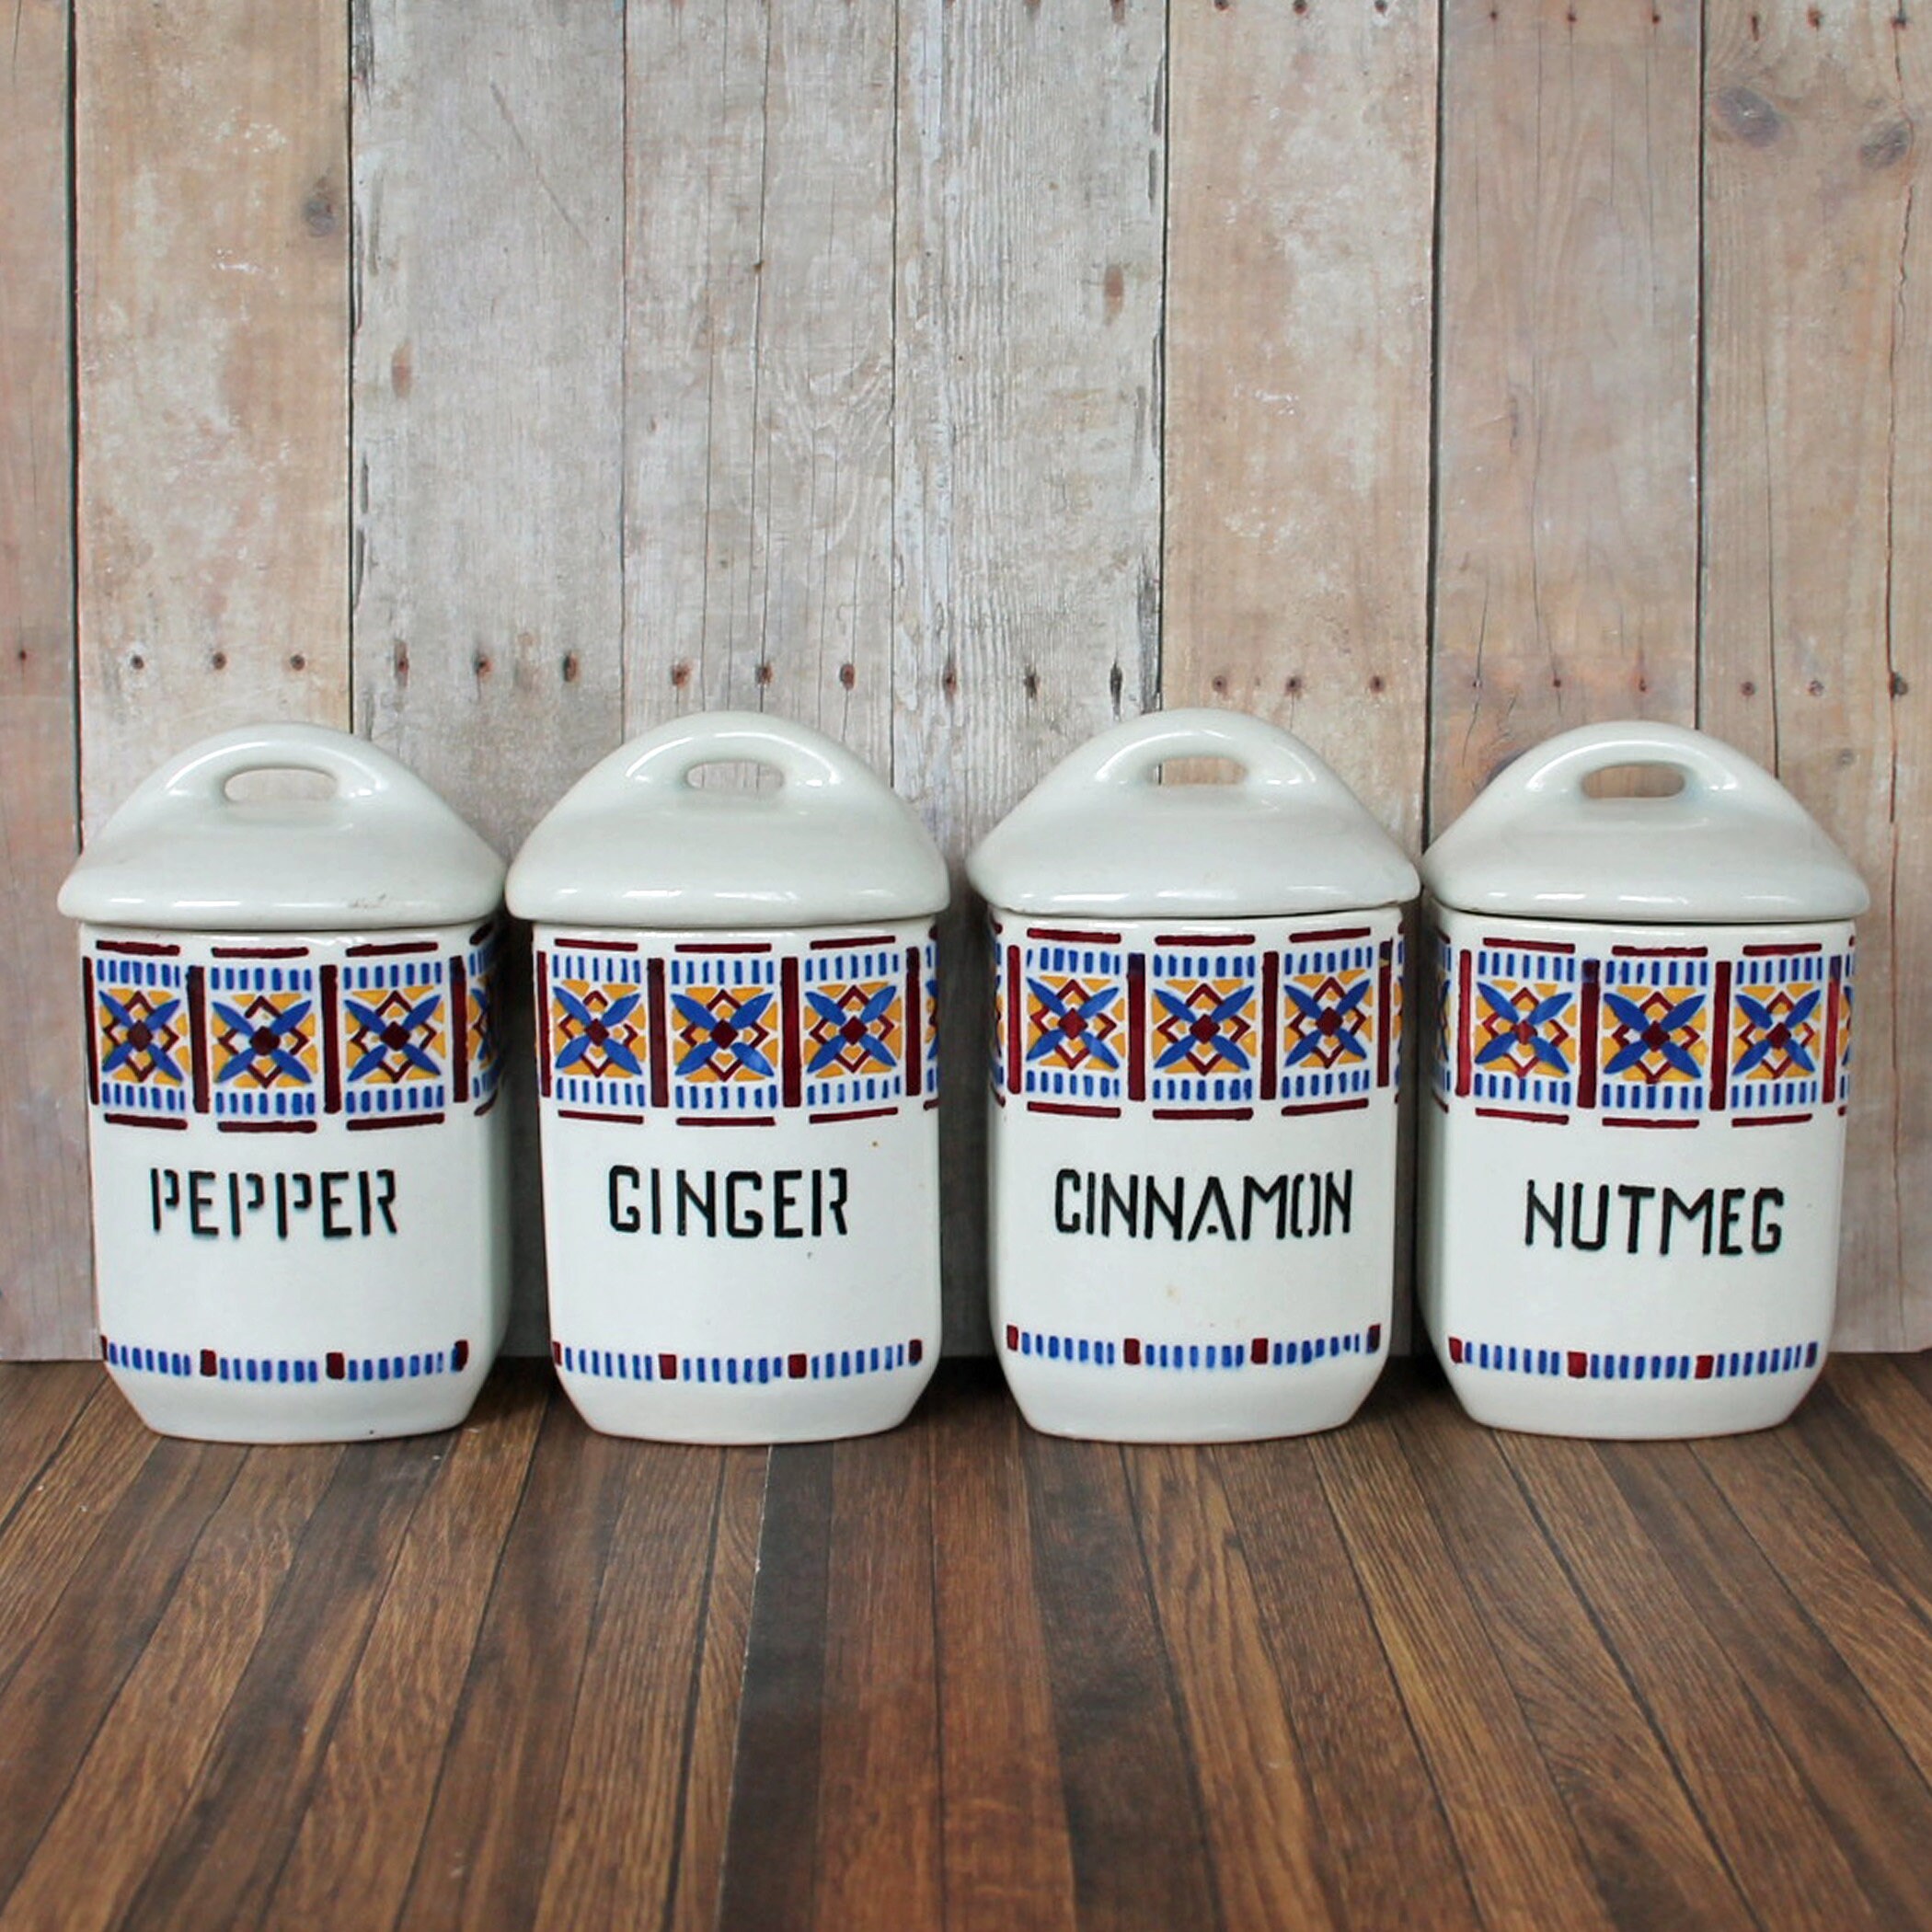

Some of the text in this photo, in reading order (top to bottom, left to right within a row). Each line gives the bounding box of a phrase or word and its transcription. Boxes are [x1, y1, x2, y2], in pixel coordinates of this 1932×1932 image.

[150, 1167, 397, 1240] PEPPER
[608, 1164, 849, 1239] GINGER
[1054, 1168, 1353, 1242] CINNAMON
[1524, 1179, 1785, 1257] NUTMEG
